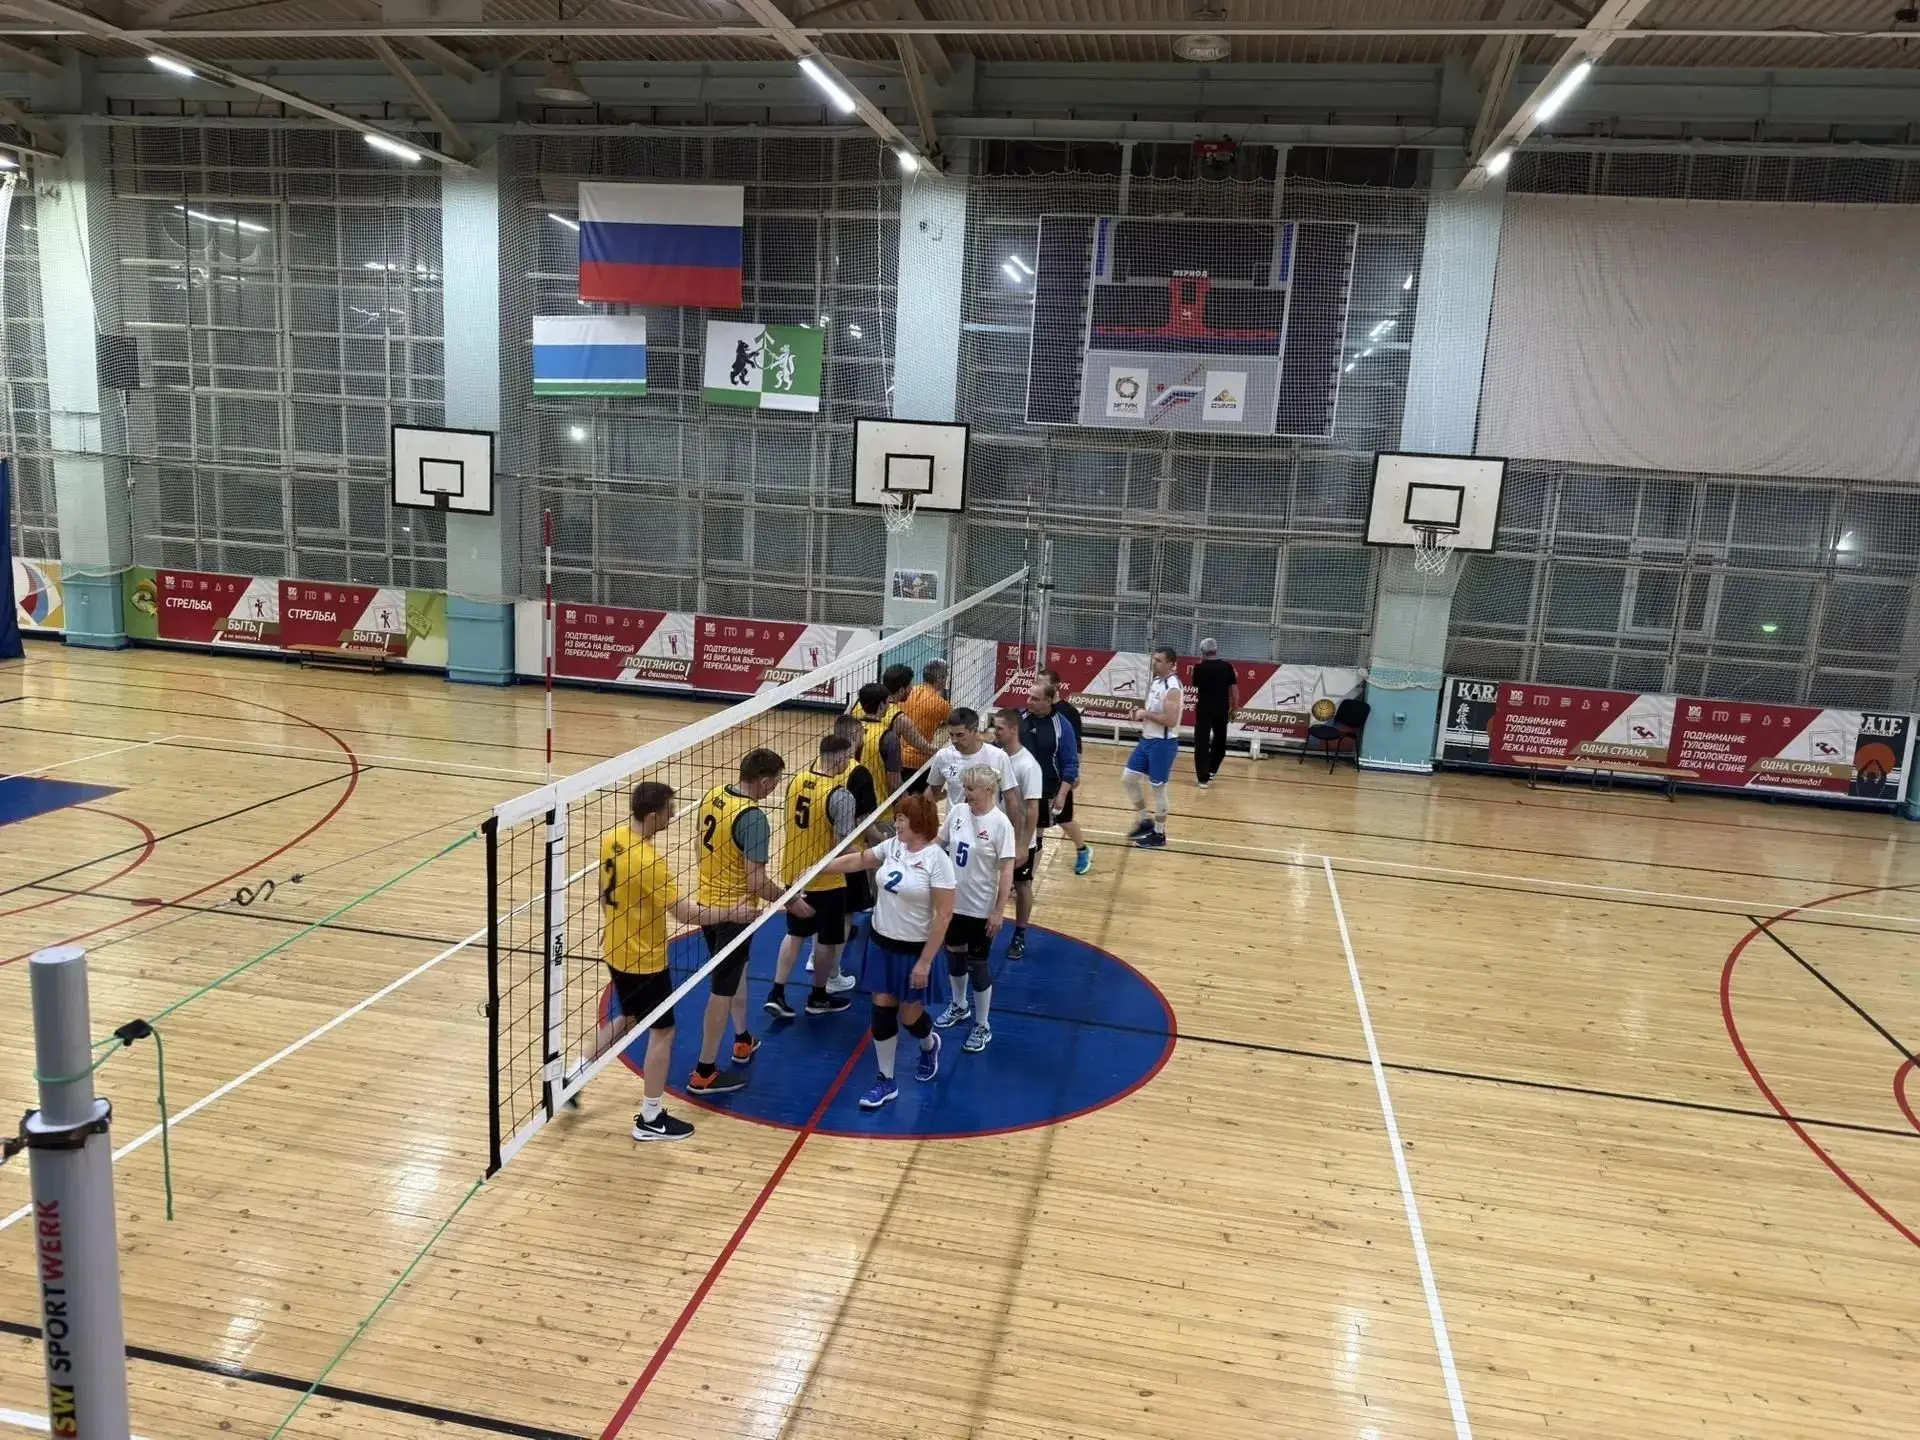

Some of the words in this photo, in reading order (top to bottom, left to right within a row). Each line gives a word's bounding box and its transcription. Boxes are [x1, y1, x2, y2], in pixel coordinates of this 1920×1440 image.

[1173, 270, 1208, 278] ПЕРИОД
[165, 597, 213, 611] СТРЕЛЬБА
[287, 608, 337, 622] СТРЕЛЬБА
[564, 631, 615, 643] ПОДТЯГИВАНИЕ
[564, 648, 611, 659] ПЕРЕКЛАДИНЕ
[603, 643, 635, 653] ВЫСОКОЙ
[703, 644, 755, 656] ПОДТЯГИВАНИЕ
[703, 653, 712, 661] ИЗ
[713, 654, 731, 662] ВИСА
[732, 655, 741, 663] НА
[742, 656, 775, 666] ВЫСОКОЙ
[703, 661, 750, 673] ПЕРЕКЛАДИНЕ
[1068, 695, 1115, 708] НОРМАТИВ
[1115, 700, 1133, 710] ГТО
[1533, 694, 1550, 706] ГТО
[1084, 709, 1105, 717] норма
[1235, 711, 1278, 722] ОРМАТИВ
[1280, 715, 1297, 724] ГТО
[1712, 710, 1730, 722] ГТО
[1505, 714, 1567, 728] ПОДНИМАНИЕ
[1270, 726, 1295, 734] жизни
[1504, 723, 1552, 736] ТУЛОВИЩА
[1502, 733, 1515, 742] ИЗ
[1515, 734, 1568, 746] ПОЛОЖЕНИЯ
[1683, 730, 1747, 744] ПОДНИМАНИЕ
[1501, 742, 1524, 752] ЛЕЖА
[1525, 744, 1538, 753] НА
[1539, 745, 1567, 756] СПИНЕ
[1580, 743, 1609, 754] ОДНА
[1610, 746, 1649, 759] СТРАНА,
[1682, 740, 1730, 753] ТУЛОВИЩА
[1680, 750, 1691, 759] ИЗ
[1692, 751, 1748, 764] ПОЛОЖЕНИЯ
[1677, 759, 1702, 770] ЛЕЖА
[1703, 761, 1715, 770] НА
[1716, 763, 1745, 773] СПИНЕ
[1760, 760, 1789, 771] ОДНА
[1791, 762, 1833, 776] СТРАНА,
[1759, 774, 1781, 783] одна
[1782, 777, 1822, 787] команда!
[795, 794, 811, 829] 5
[704, 814, 716, 853] 2
[955, 841, 970, 868] 5
[884, 870, 903, 895] 2
[51, 1383, 78, 1438] SW
